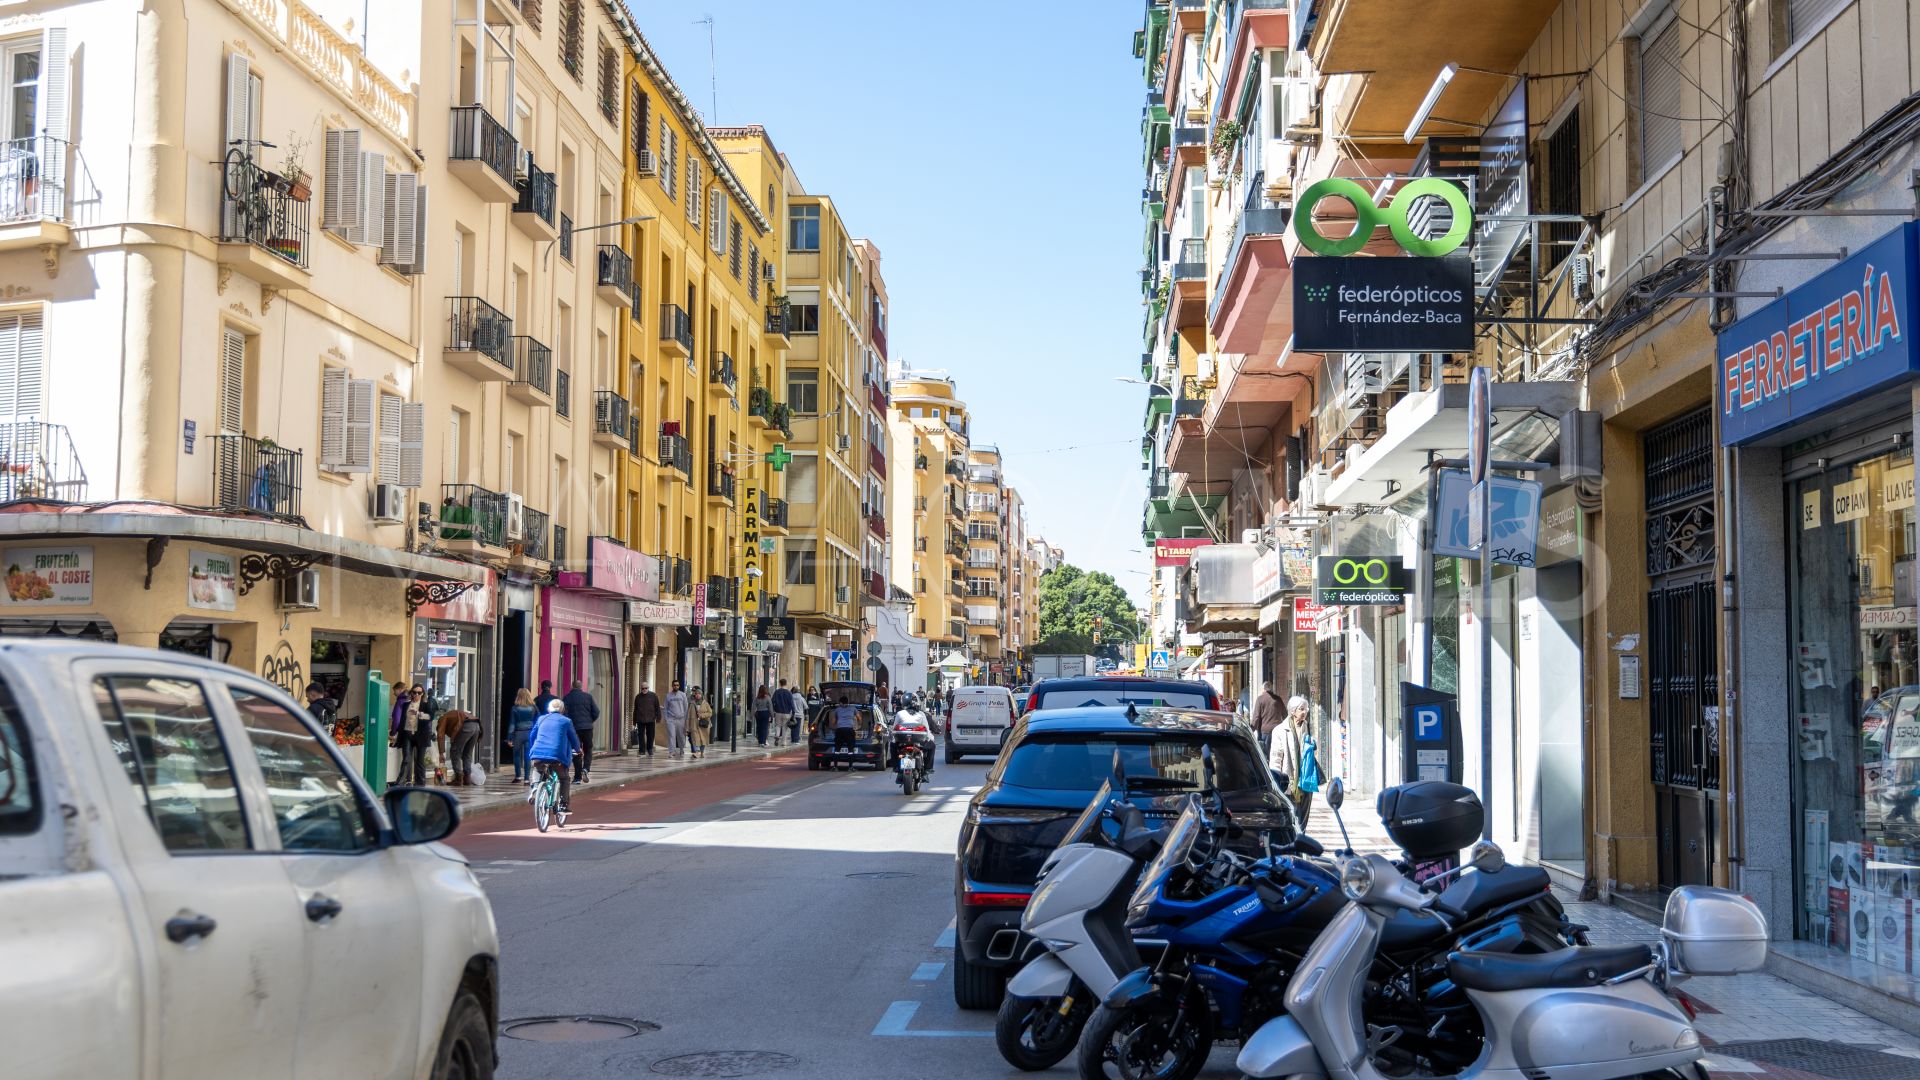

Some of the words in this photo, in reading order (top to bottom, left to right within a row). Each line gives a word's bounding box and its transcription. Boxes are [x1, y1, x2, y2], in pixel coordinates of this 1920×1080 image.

[1484, 143, 1509, 192] LENTES
[1509, 127, 1519, 162] DE
[1483, 175, 1522, 238] CONTACTO
[1337, 285, 1463, 306] federópticos
[1338, 309, 1463, 323] Fernández-Baca
[1724, 263, 1901, 416] FERRETERÍA
[1805, 505, 1813, 521] SE
[744, 488, 758, 602] FARMACIA
[35, 551, 80, 568] FRUTERÍA
[48, 571, 59, 584] AL
[62, 570, 90, 584] COSTE
[696, 584, 704, 625] OBRADOR
[1339, 592, 1400, 603] federópticos
[643, 606, 680, 620] CARMEN
[1418, 711, 1438, 736] P
